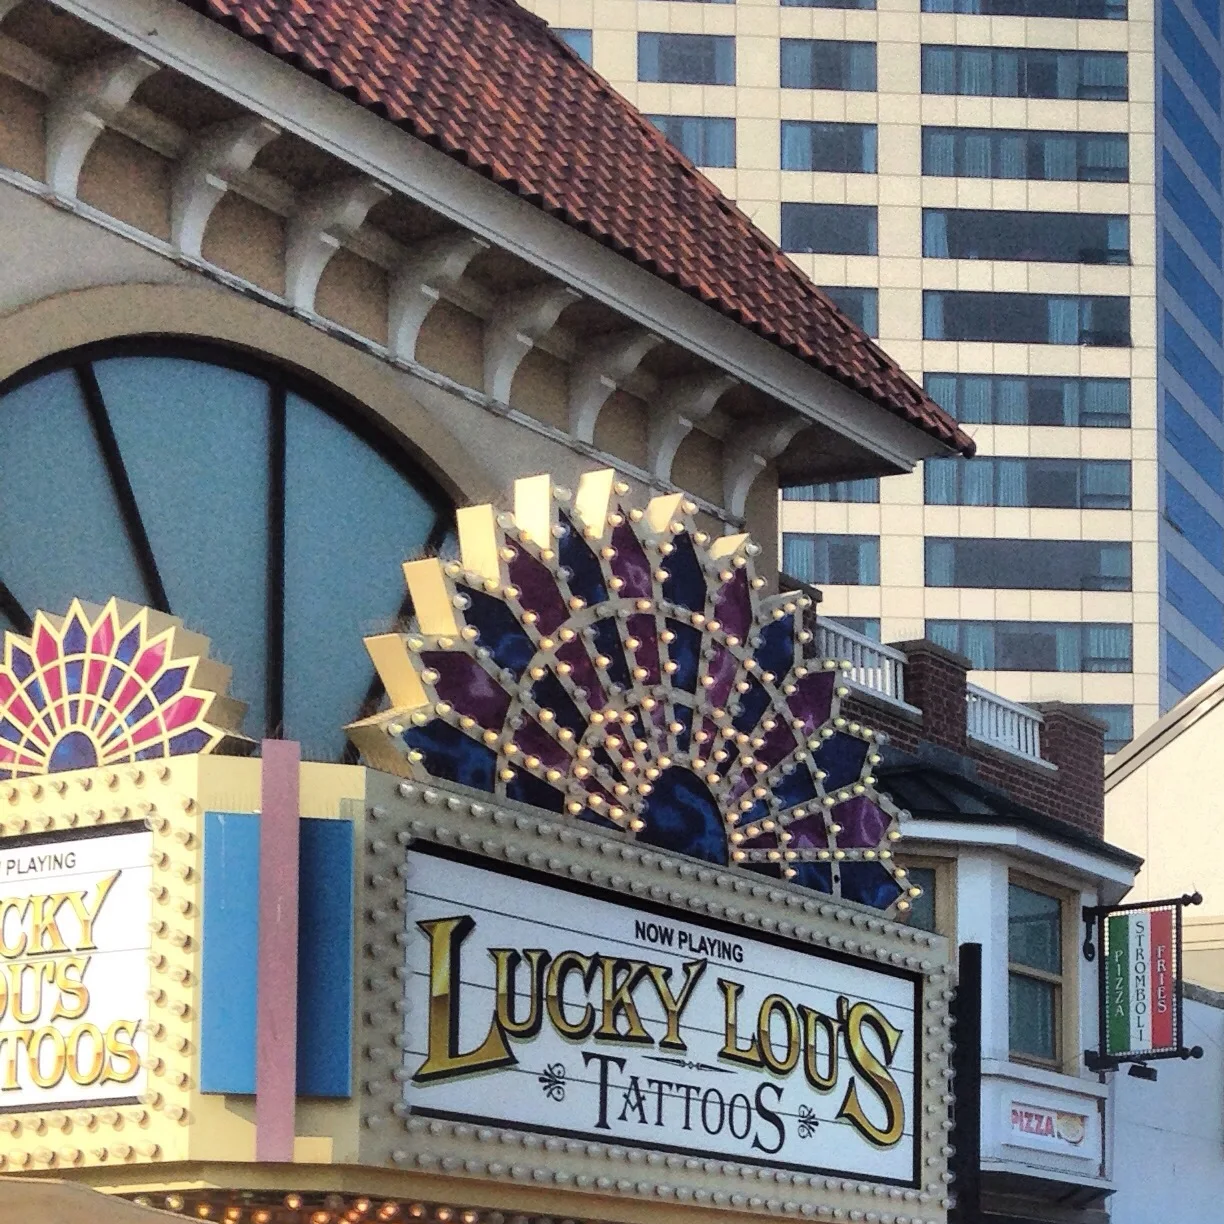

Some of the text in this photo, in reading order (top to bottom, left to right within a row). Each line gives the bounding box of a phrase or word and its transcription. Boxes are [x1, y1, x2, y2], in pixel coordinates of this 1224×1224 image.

[6, 851, 77, 876] PLAYING
[634, 919, 744, 963] NOW PLAYING
[1114, 949, 1125, 1017] PIZZA
[1134, 920, 1147, 1042] STROMBOLI
[1156, 945, 1168, 1013] FRIES
[411, 914, 905, 1150] LUCKY LOU'S
[581, 1050, 786, 1155] TATTOOS
[1010, 1108, 1056, 1139] PIZZA
